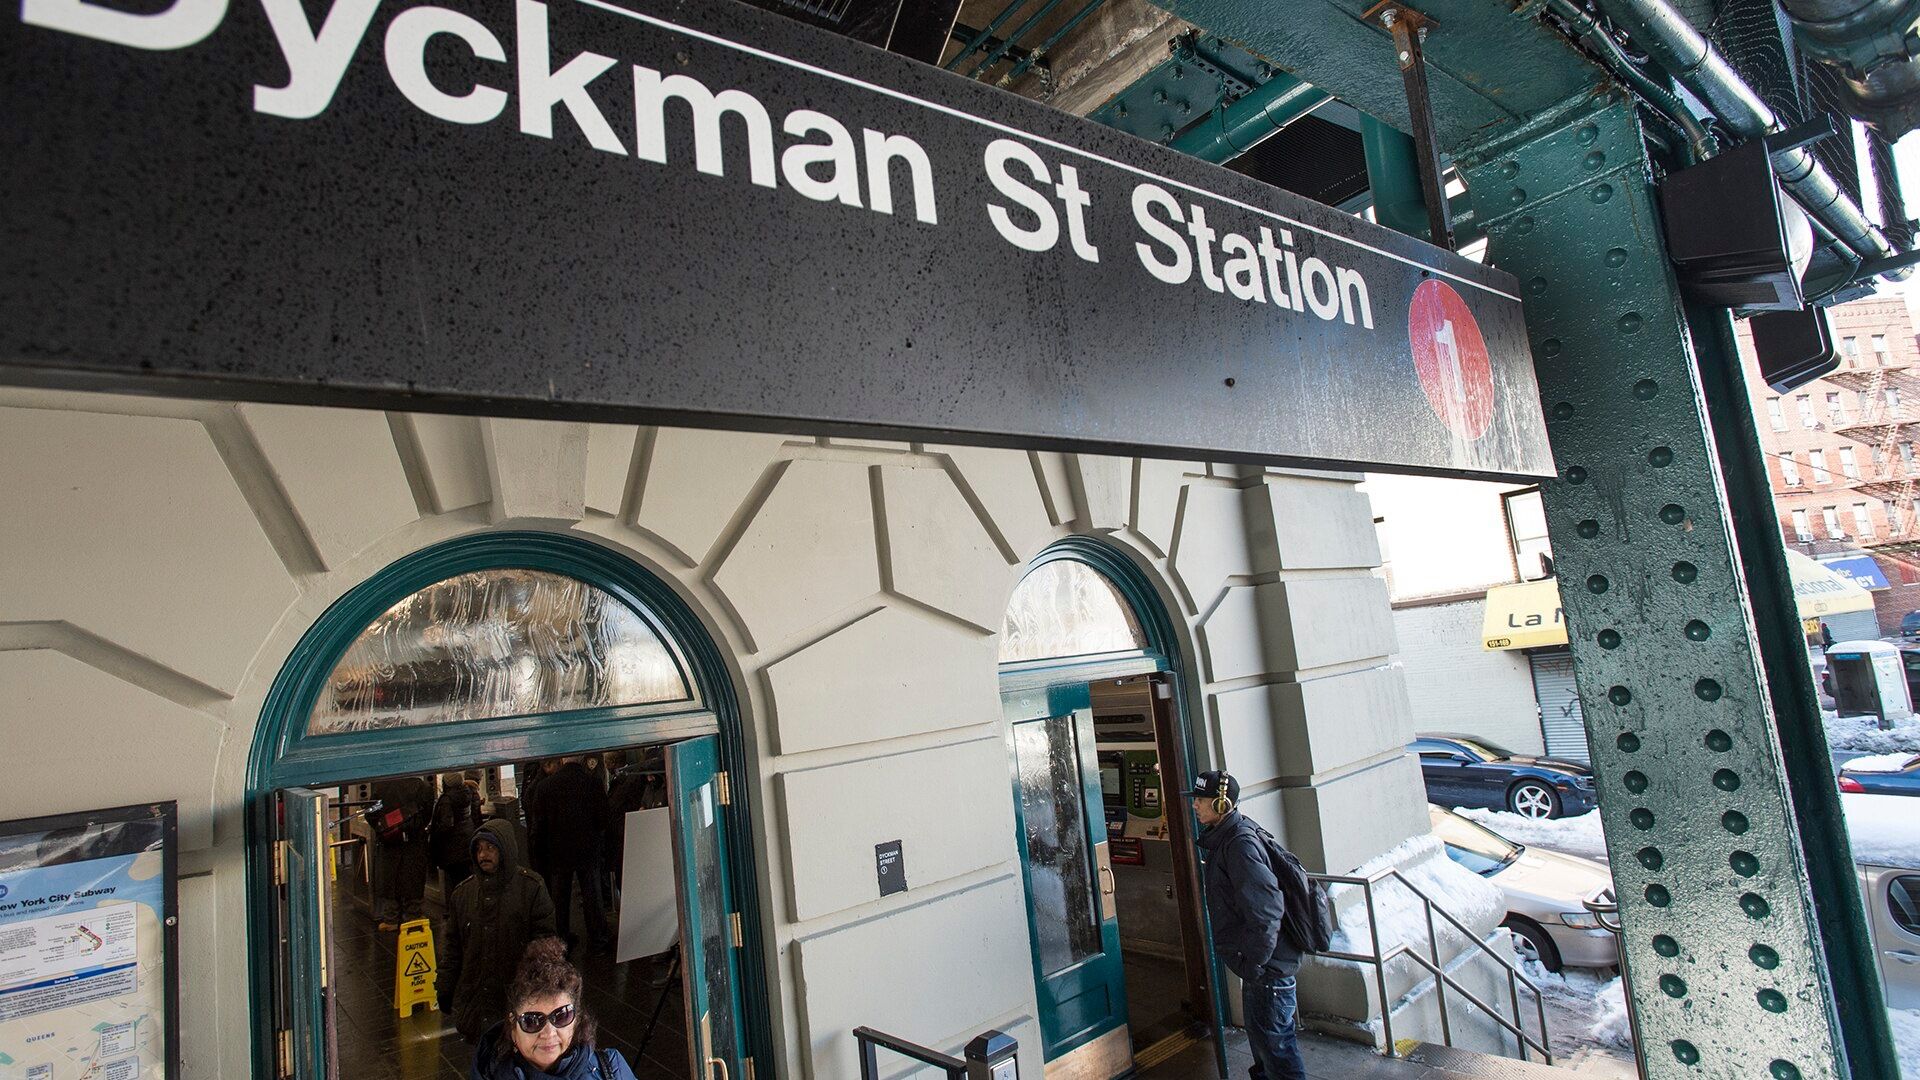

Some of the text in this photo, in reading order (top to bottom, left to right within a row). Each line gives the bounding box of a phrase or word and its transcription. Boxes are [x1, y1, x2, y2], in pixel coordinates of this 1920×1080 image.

[20, 0, 1374, 330] yckman St Station
[1435, 319, 1465, 402] 1
[1508, 613, 1542, 628] La
[20, 897, 46, 908] York
[48, 894, 71, 903] City
[74, 886, 117, 899] Subway
[405, 941, 429, 951] CAUTION
[26, 1032, 55, 1043] QUEENS
